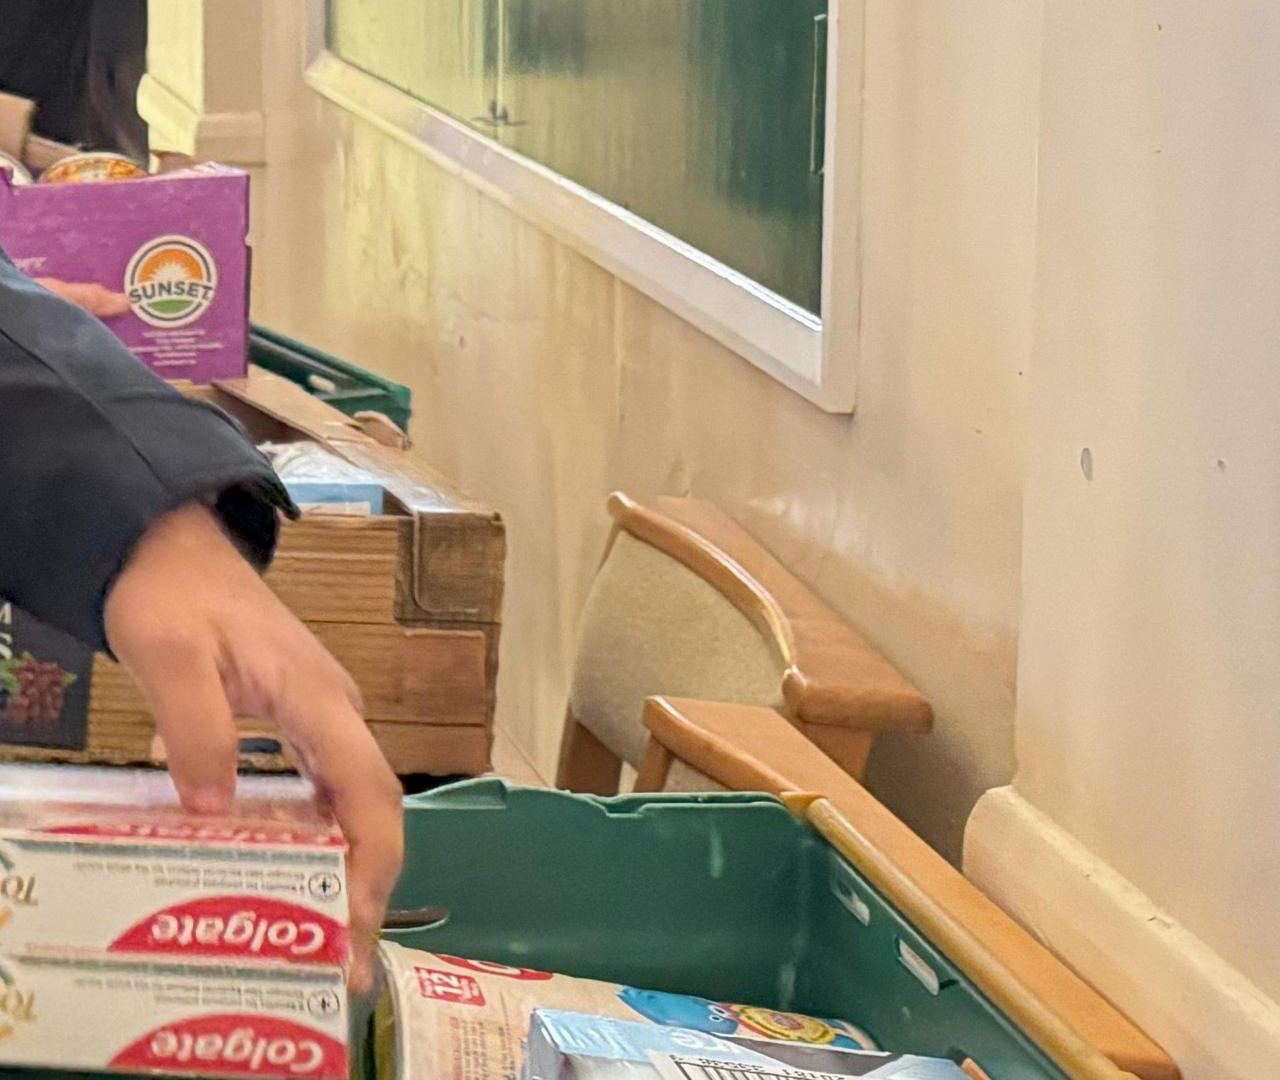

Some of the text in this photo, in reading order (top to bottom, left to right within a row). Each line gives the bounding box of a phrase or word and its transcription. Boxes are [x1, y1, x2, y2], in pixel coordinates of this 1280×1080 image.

[129, 281, 213, 304] SUNSET
[151, 910, 325, 952] Colgate
[150, 1027, 325, 1072] Colgate
